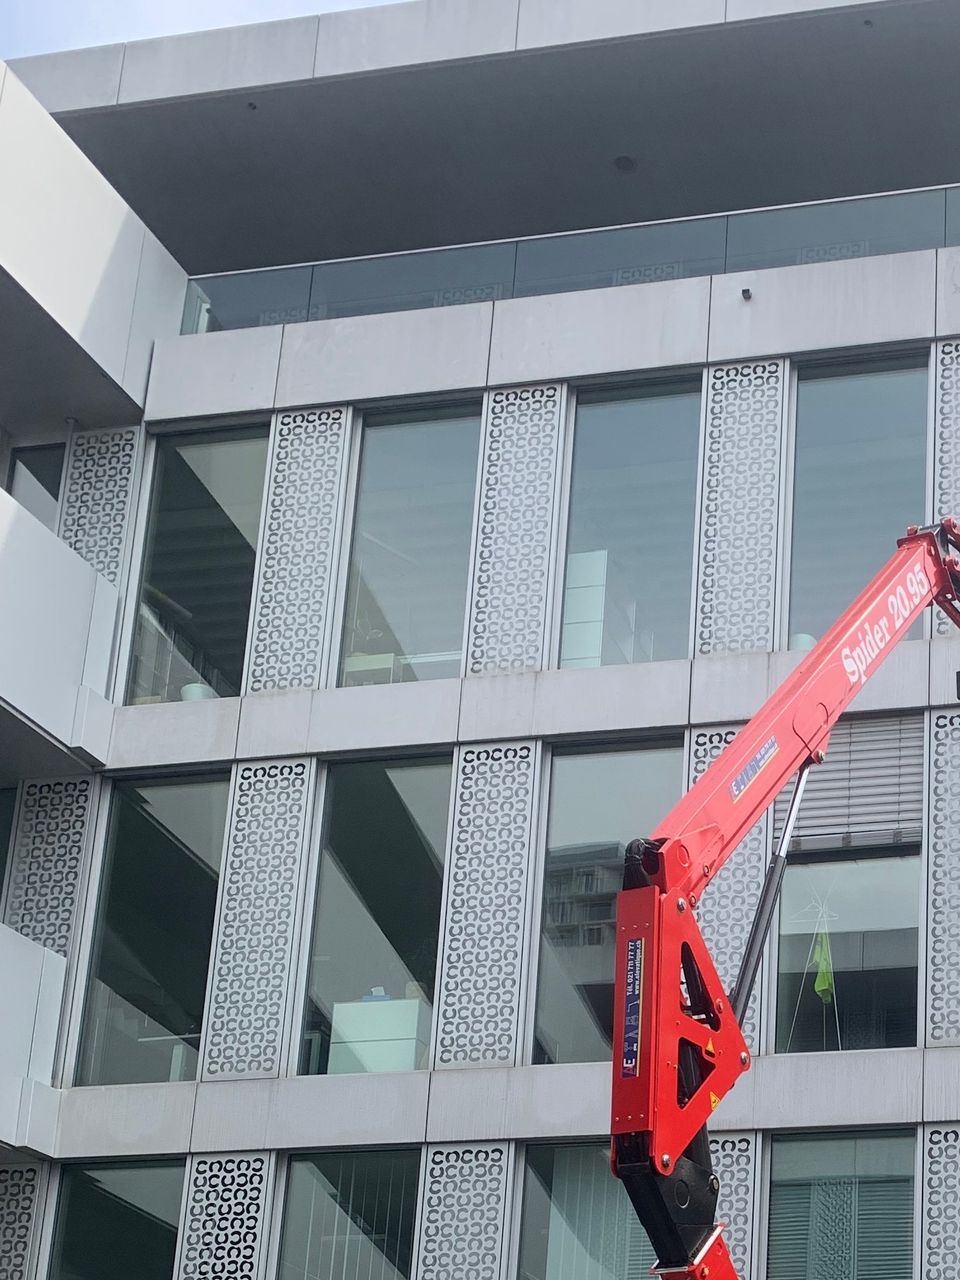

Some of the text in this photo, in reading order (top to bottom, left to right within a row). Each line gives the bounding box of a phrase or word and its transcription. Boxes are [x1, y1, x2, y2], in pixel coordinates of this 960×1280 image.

[841, 561, 929, 686] Spider 20.95
[628, 941, 635, 951] 77
[628, 951, 635, 960] 77
